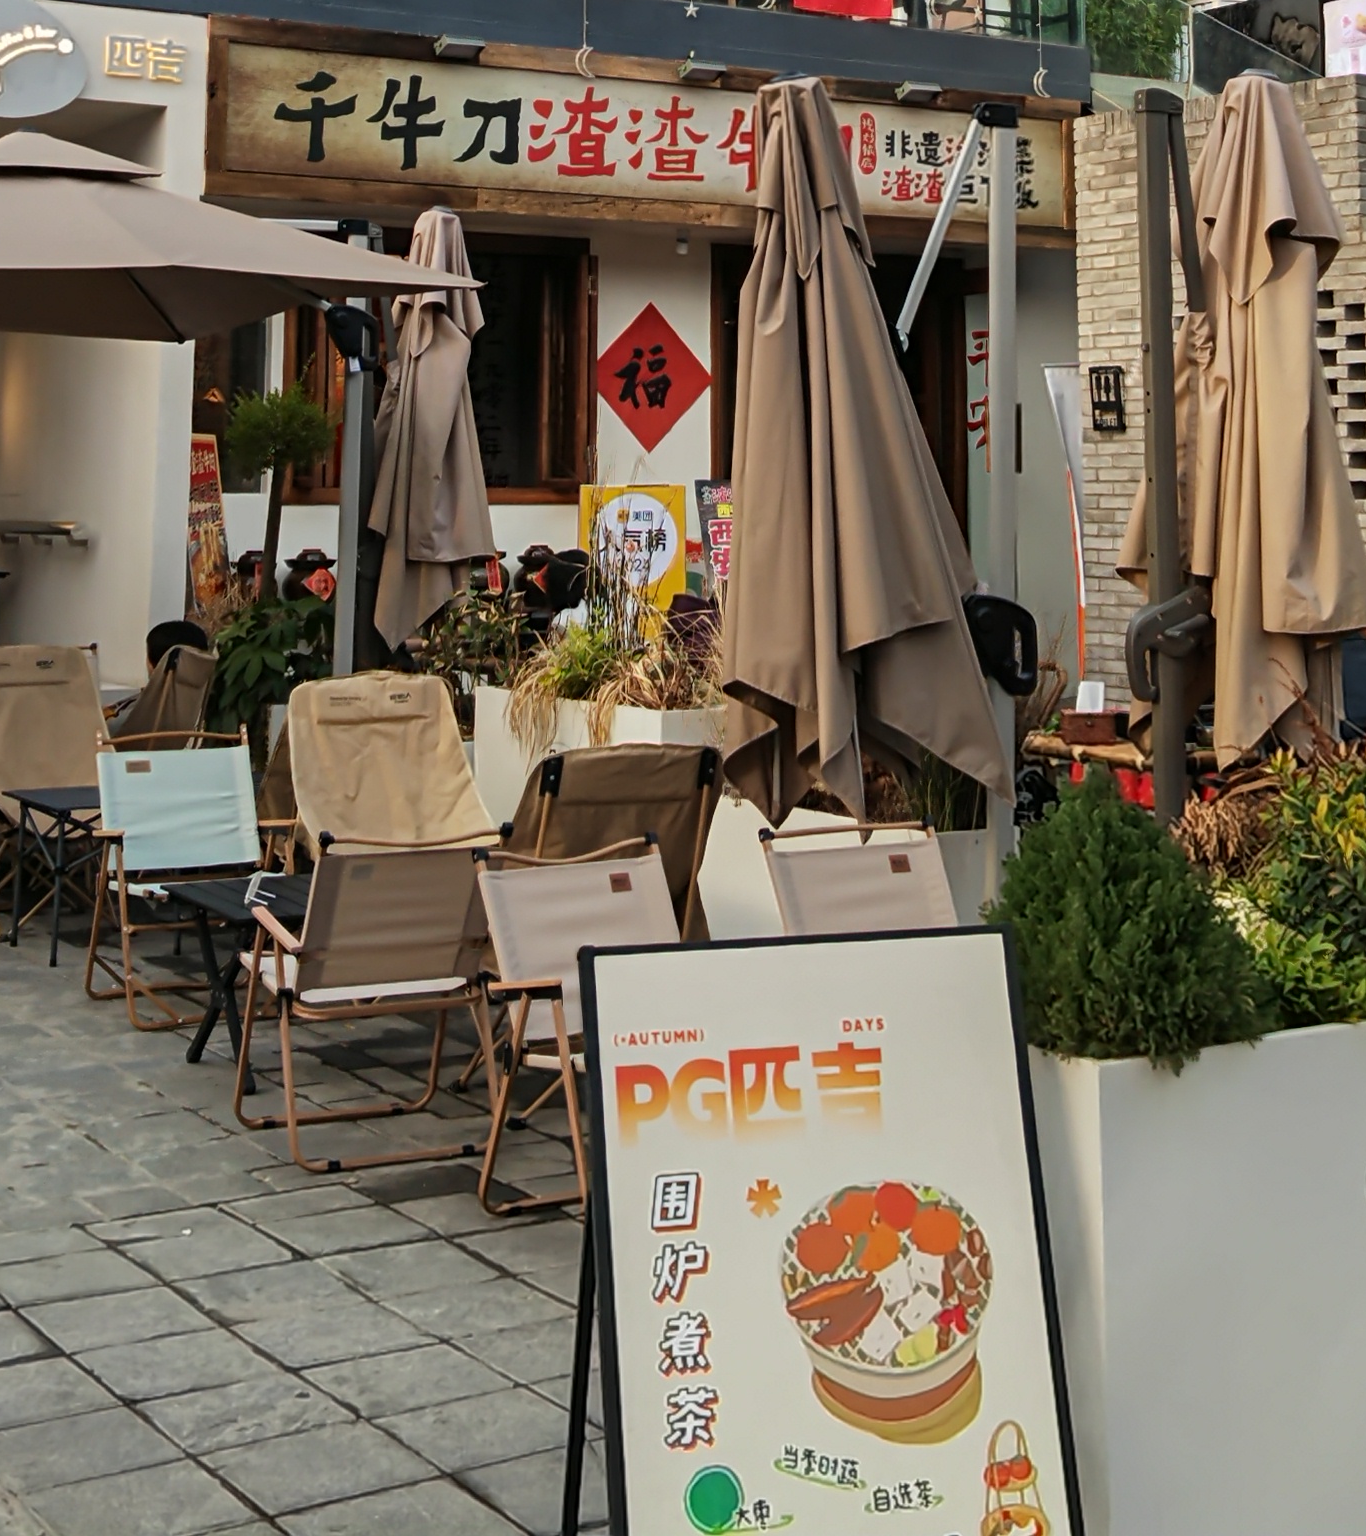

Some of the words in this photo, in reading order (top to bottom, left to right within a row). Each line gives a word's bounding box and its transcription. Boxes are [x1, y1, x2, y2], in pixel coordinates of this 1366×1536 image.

[614, 343, 673, 410] 福
[841, 1017, 886, 1034] DAYS
[649, 1170, 721, 1452] 围炉煮茶
